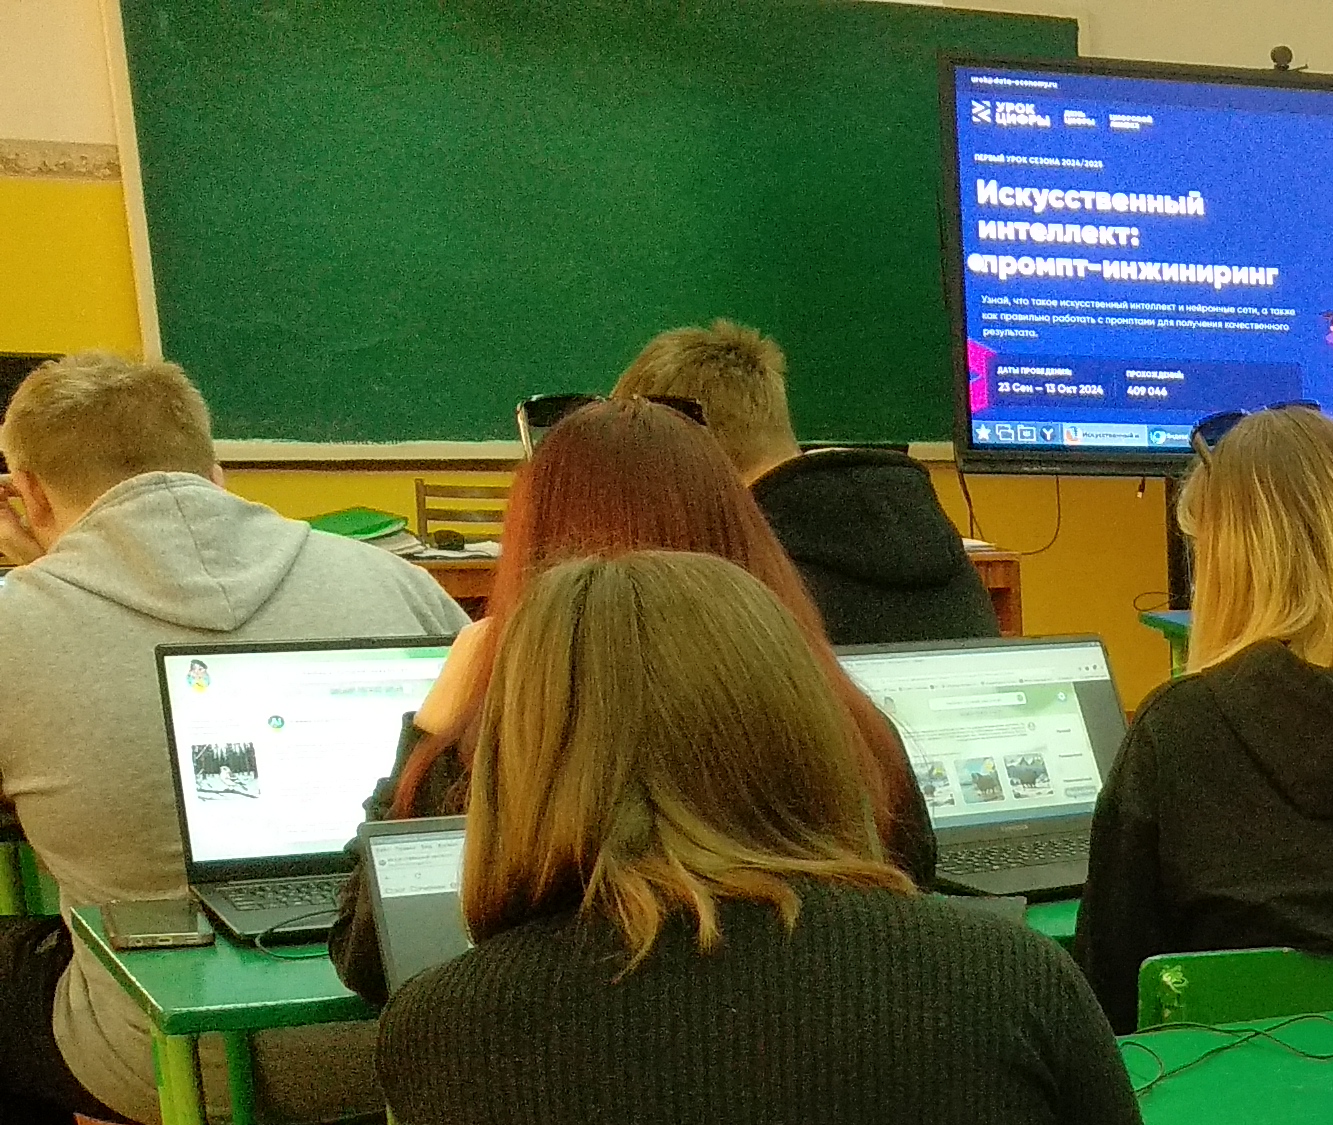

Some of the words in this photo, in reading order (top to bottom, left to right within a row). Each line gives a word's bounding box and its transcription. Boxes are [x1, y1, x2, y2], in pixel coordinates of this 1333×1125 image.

[995, 101, 1036, 115] УРОК
[995, 113, 1051, 128] ЦИФРЫ
[974, 153, 1005, 163] ПЕРВЫЙ
[1006, 155, 1028, 164] УРОК
[1029, 156, 1060, 167] СЕЗОНА
[1061, 158, 1104, 169] 2024/2025
[976, 178, 1205, 216] Искусственный
[978, 219, 1141, 248] интеллект:
[982, 253, 1279, 289] промпт-инжиниринг
[980, 294, 1011, 306] Узнай,
[1012, 298, 1029, 306] что
[1031, 299, 1058, 307] такое
[1059, 299, 1128, 310] искусственный
[1129, 302, 1176, 312] интеллект
[1186, 305, 1236, 315] нейронные
[1270, 309, 1296, 317] также
[982, 313, 998, 321] как
[999, 313, 1050, 323] правильно
[1052, 314, 1096, 325] работать
[1105, 317, 1155, 328] промптами
[1157, 319, 1174, 328] для
[1175, 320, 1223, 330] получения
[1224, 321, 1290, 332] качественного
[982, 328, 1039, 339] результата.
[997, 366, 1020, 376] ДАТЫ
[997, 382, 1011, 393] 23
[1012, 382, 1034, 394] Сен
[1045, 383, 1056, 395] 13
[1057, 384, 1078, 395] Окт
[1079, 384, 1104, 396] 2024
[1127, 385, 1146, 397] 409
[1147, 386, 1168, 398] 046
